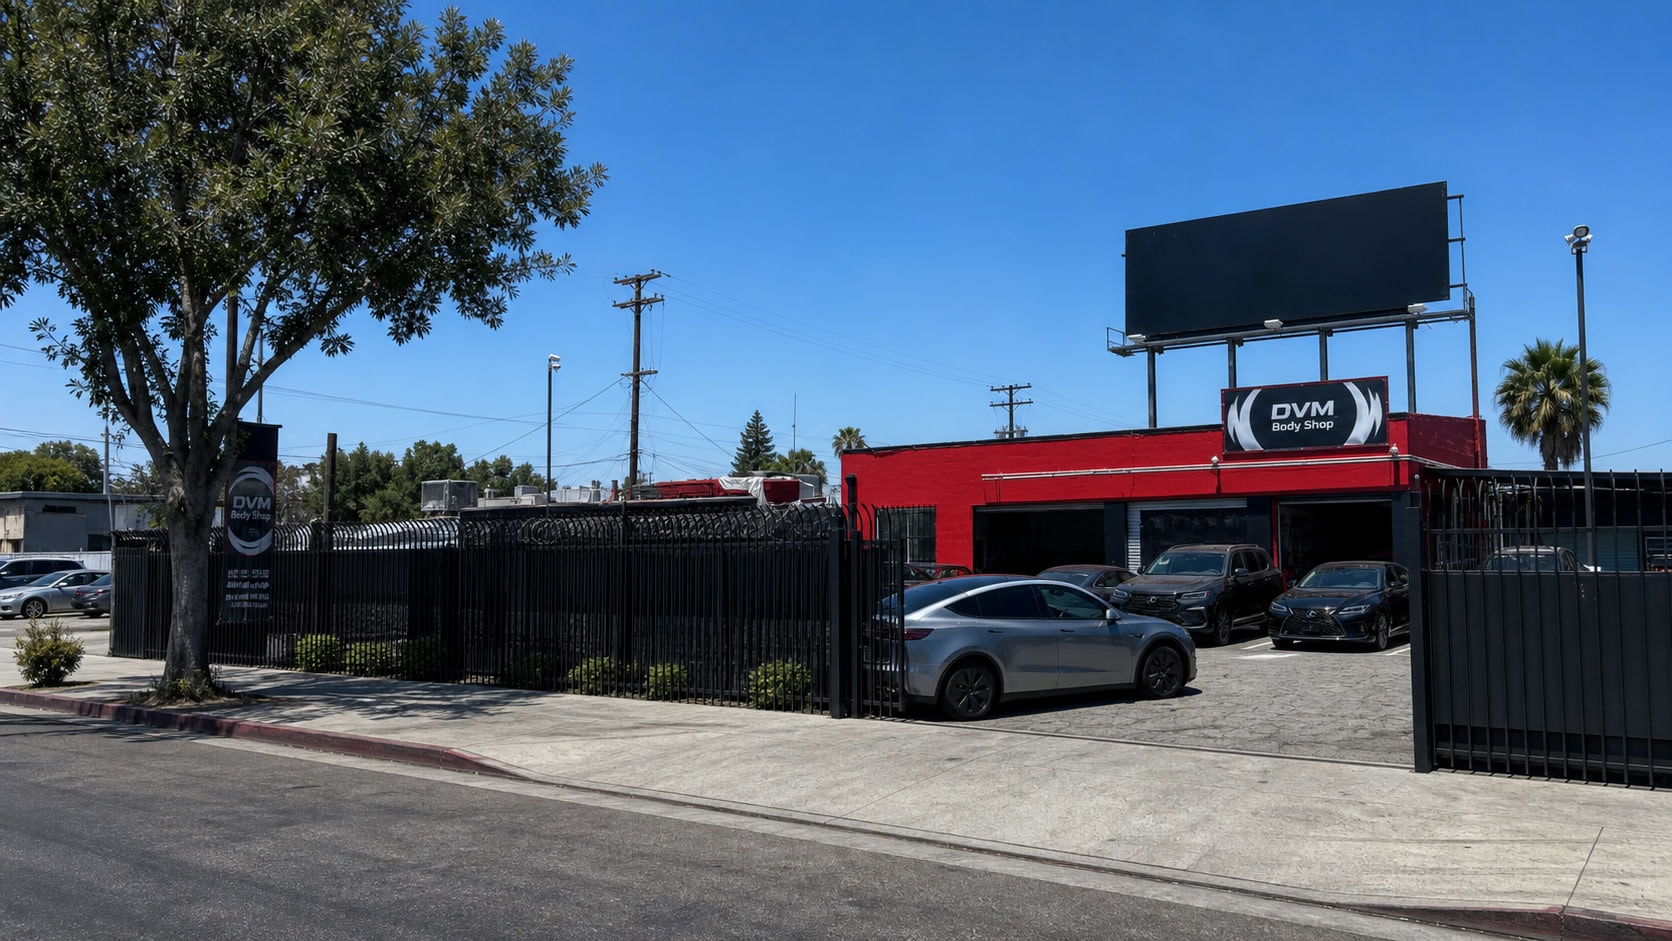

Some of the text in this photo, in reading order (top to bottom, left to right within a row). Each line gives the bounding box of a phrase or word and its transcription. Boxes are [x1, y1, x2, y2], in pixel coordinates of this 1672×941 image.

[1271, 400, 1334, 420] DVM
[1272, 420, 1334, 433] Body Shop
[232, 496, 271, 510] DVM
[230, 510, 271, 523] Body Shop
